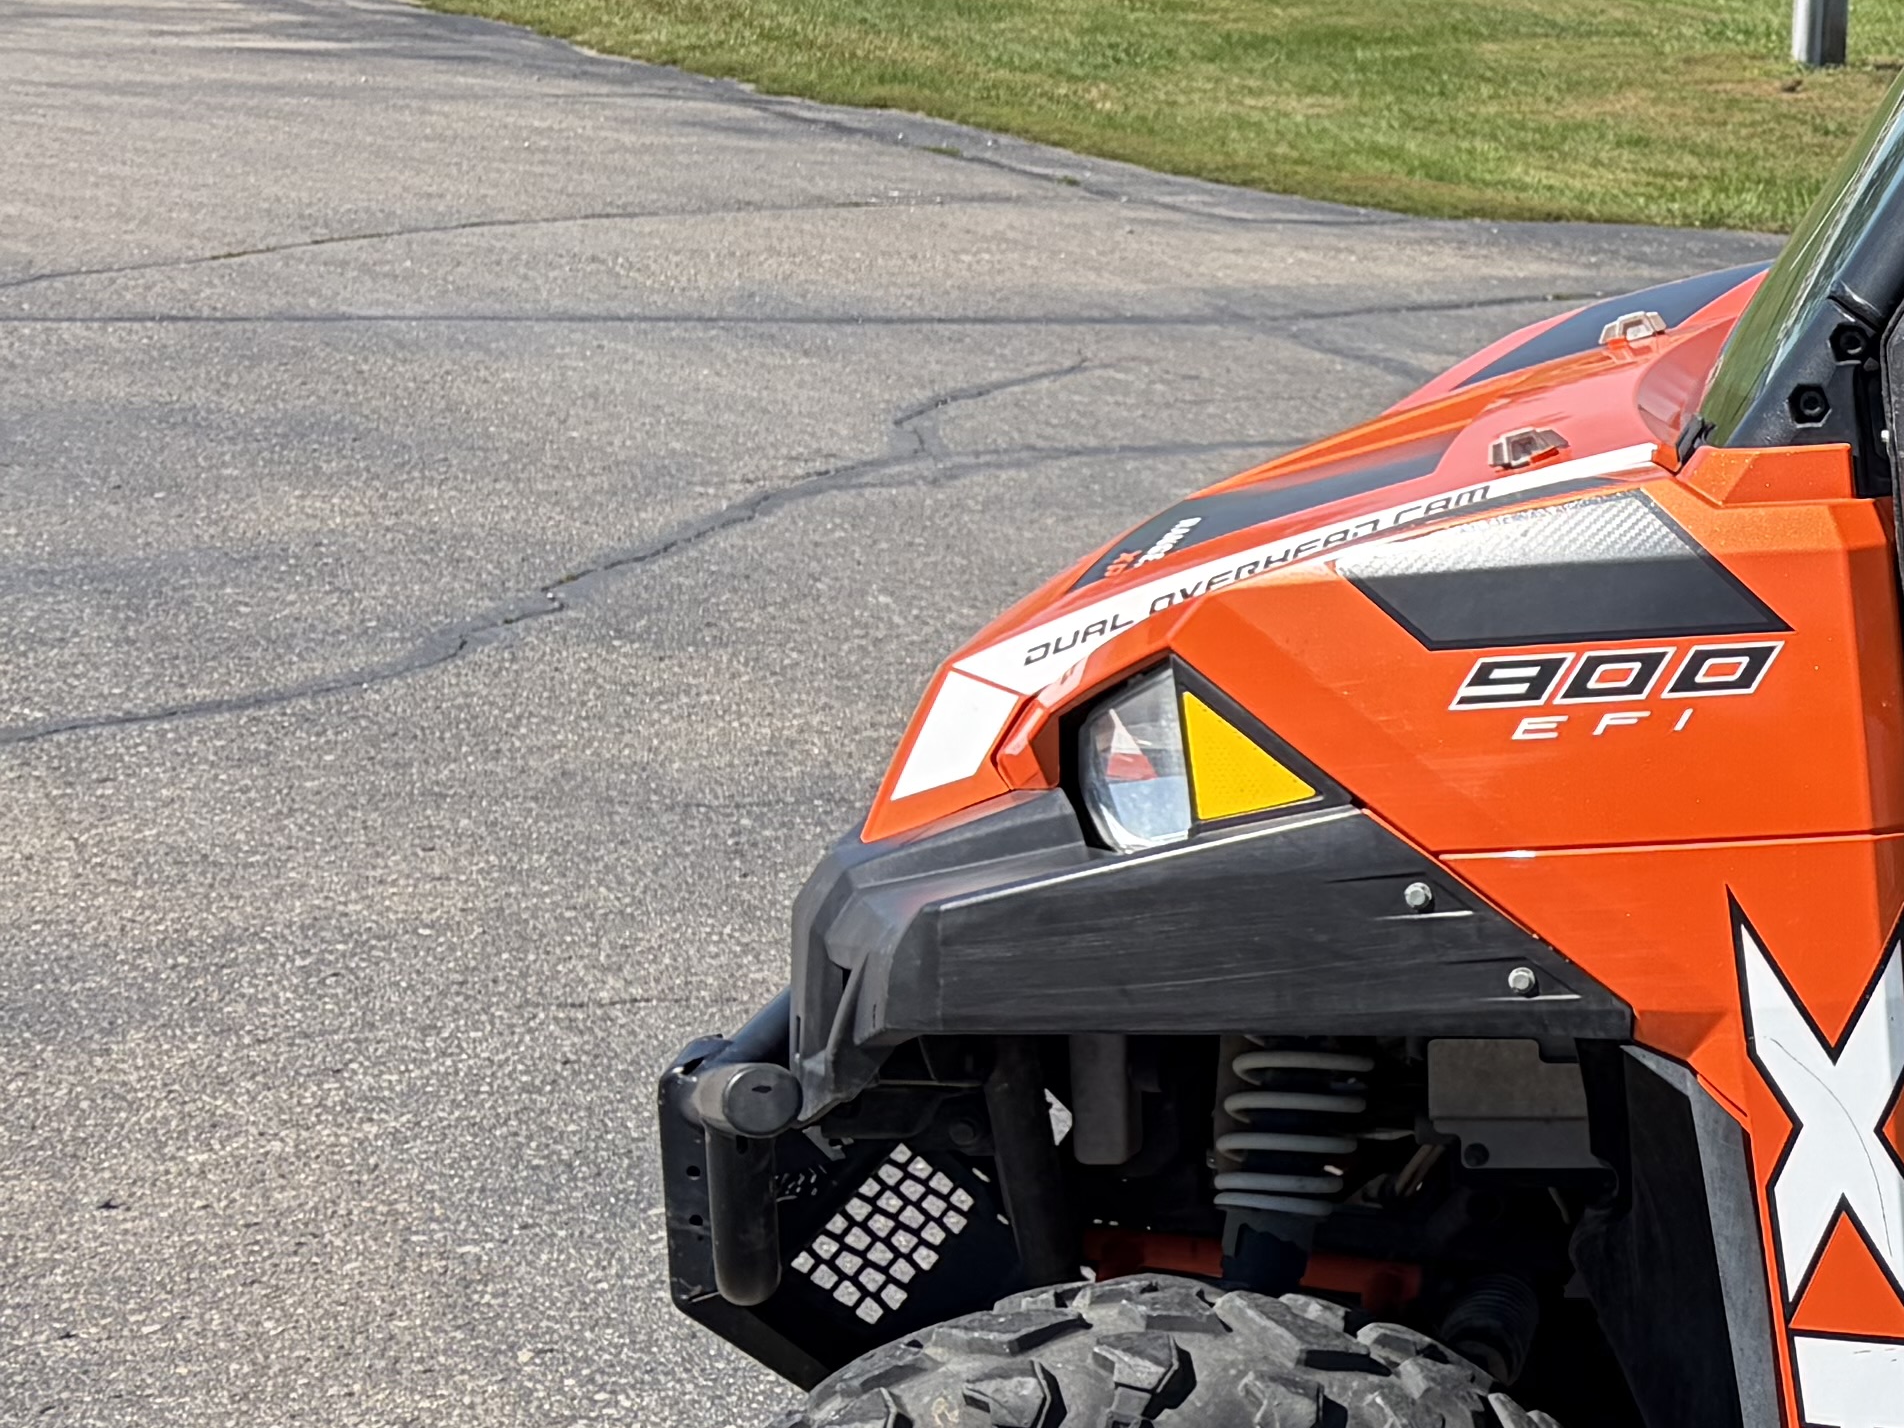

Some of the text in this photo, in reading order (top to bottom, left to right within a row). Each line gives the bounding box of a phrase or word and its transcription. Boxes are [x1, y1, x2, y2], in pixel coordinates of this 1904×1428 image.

[1023, 484, 1491, 667] DUAL OVERHEAD CAM
[1448, 639, 1786, 712] 900
[1511, 707, 1694, 741] EFI
